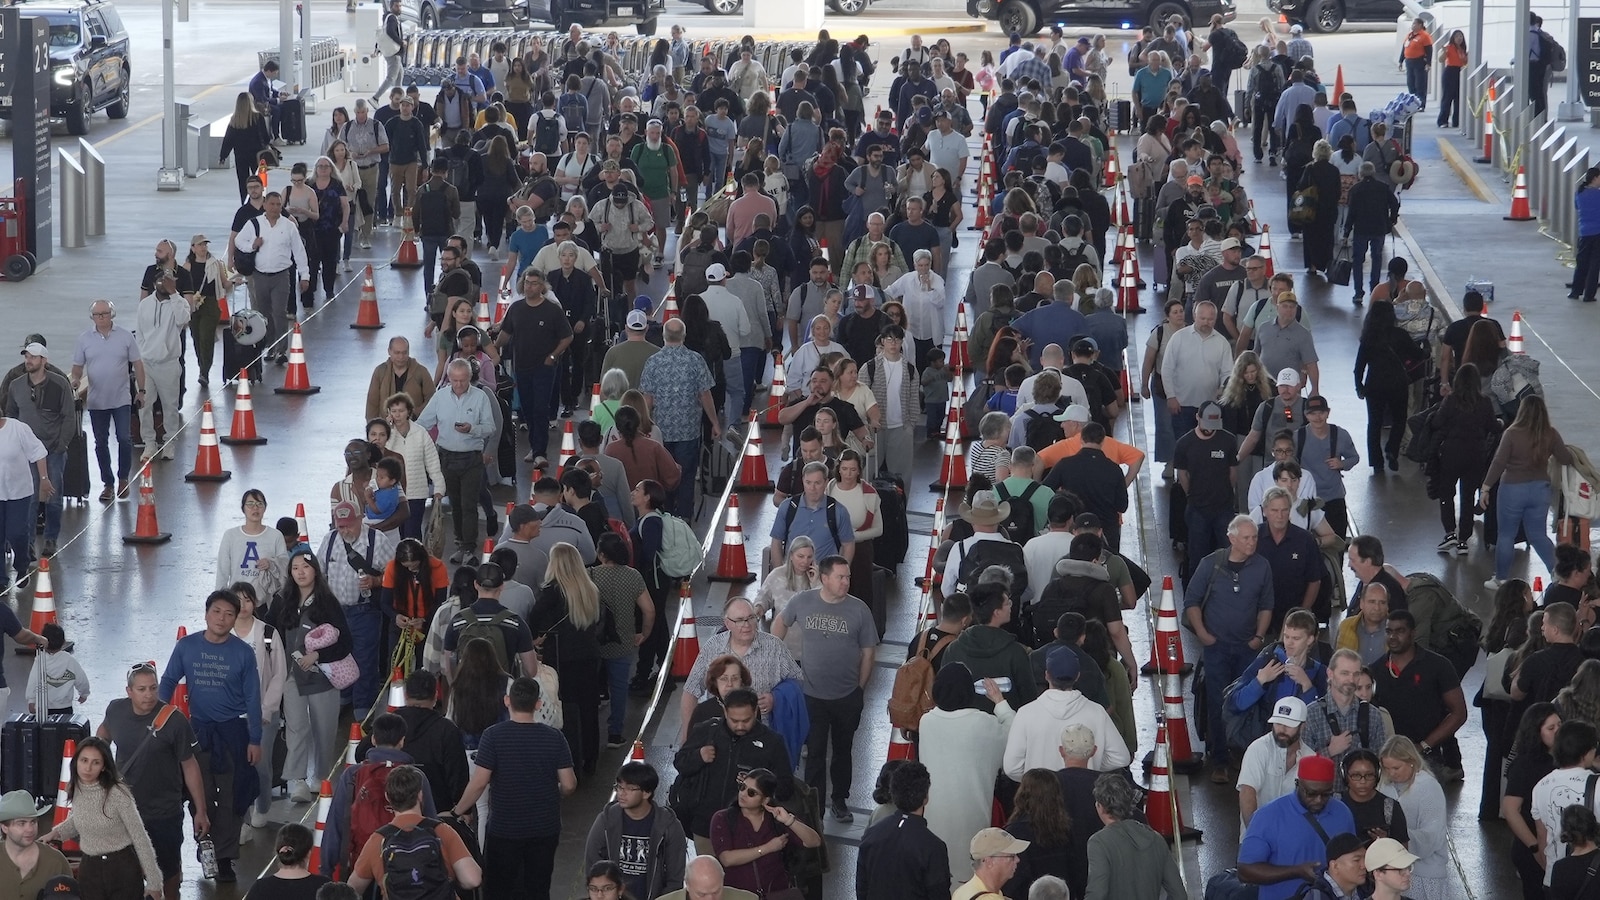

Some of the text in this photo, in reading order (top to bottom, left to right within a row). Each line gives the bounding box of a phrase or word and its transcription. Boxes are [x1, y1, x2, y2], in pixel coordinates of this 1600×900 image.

[240, 541, 259, 568] A
[805, 615, 849, 634] MESA
[201, 652, 218, 660] There
[54, 882, 70, 892] abc
